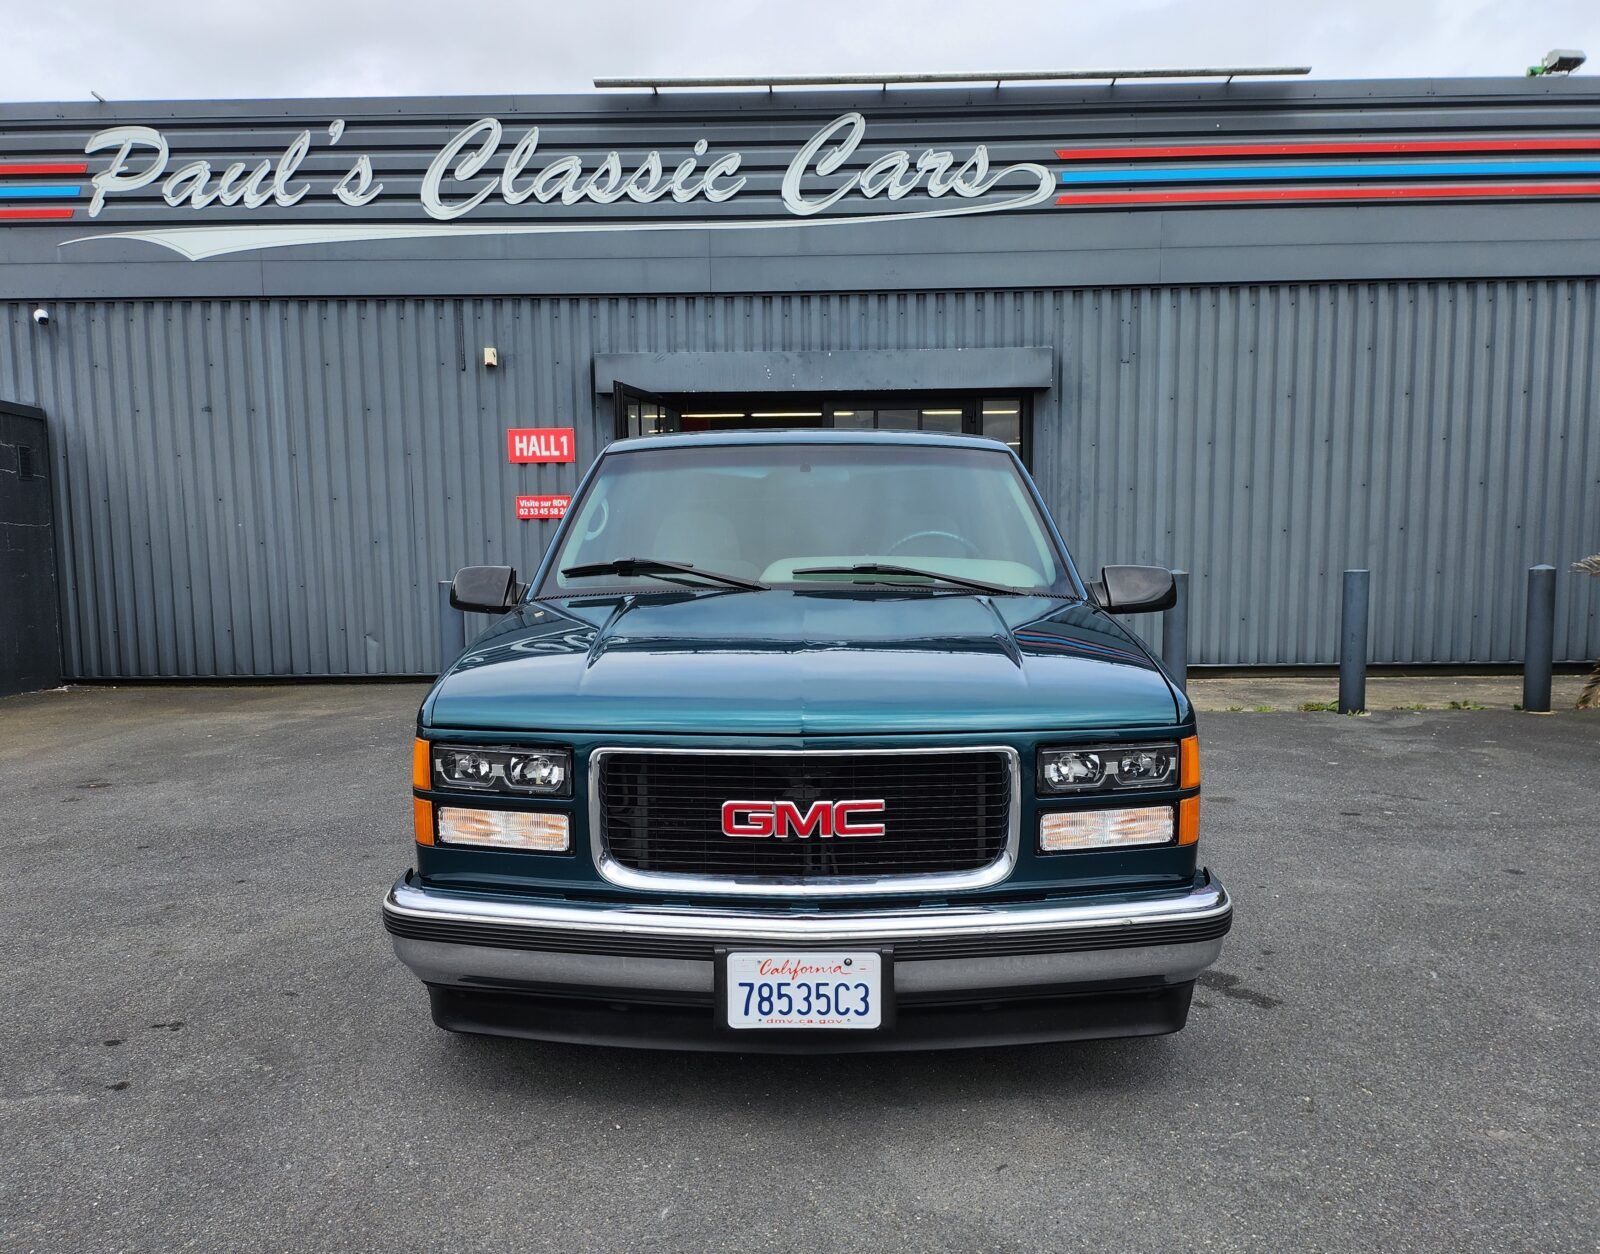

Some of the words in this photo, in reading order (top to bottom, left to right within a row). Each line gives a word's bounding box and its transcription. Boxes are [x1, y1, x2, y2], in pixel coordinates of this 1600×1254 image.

[85, 119, 384, 219] Paul's
[419, 117, 748, 222] Classic
[781, 112, 1056, 216] Cars
[519, 499, 540, 507] Visite
[552, 499, 568, 507] RDV
[519, 508, 529, 516] 02
[529, 508, 538, 516] 33
[539, 508, 549, 516] 45
[722, 799, 886, 838] GMC
[759, 958, 852, 980] California
[738, 982, 870, 1017] 78535C3
